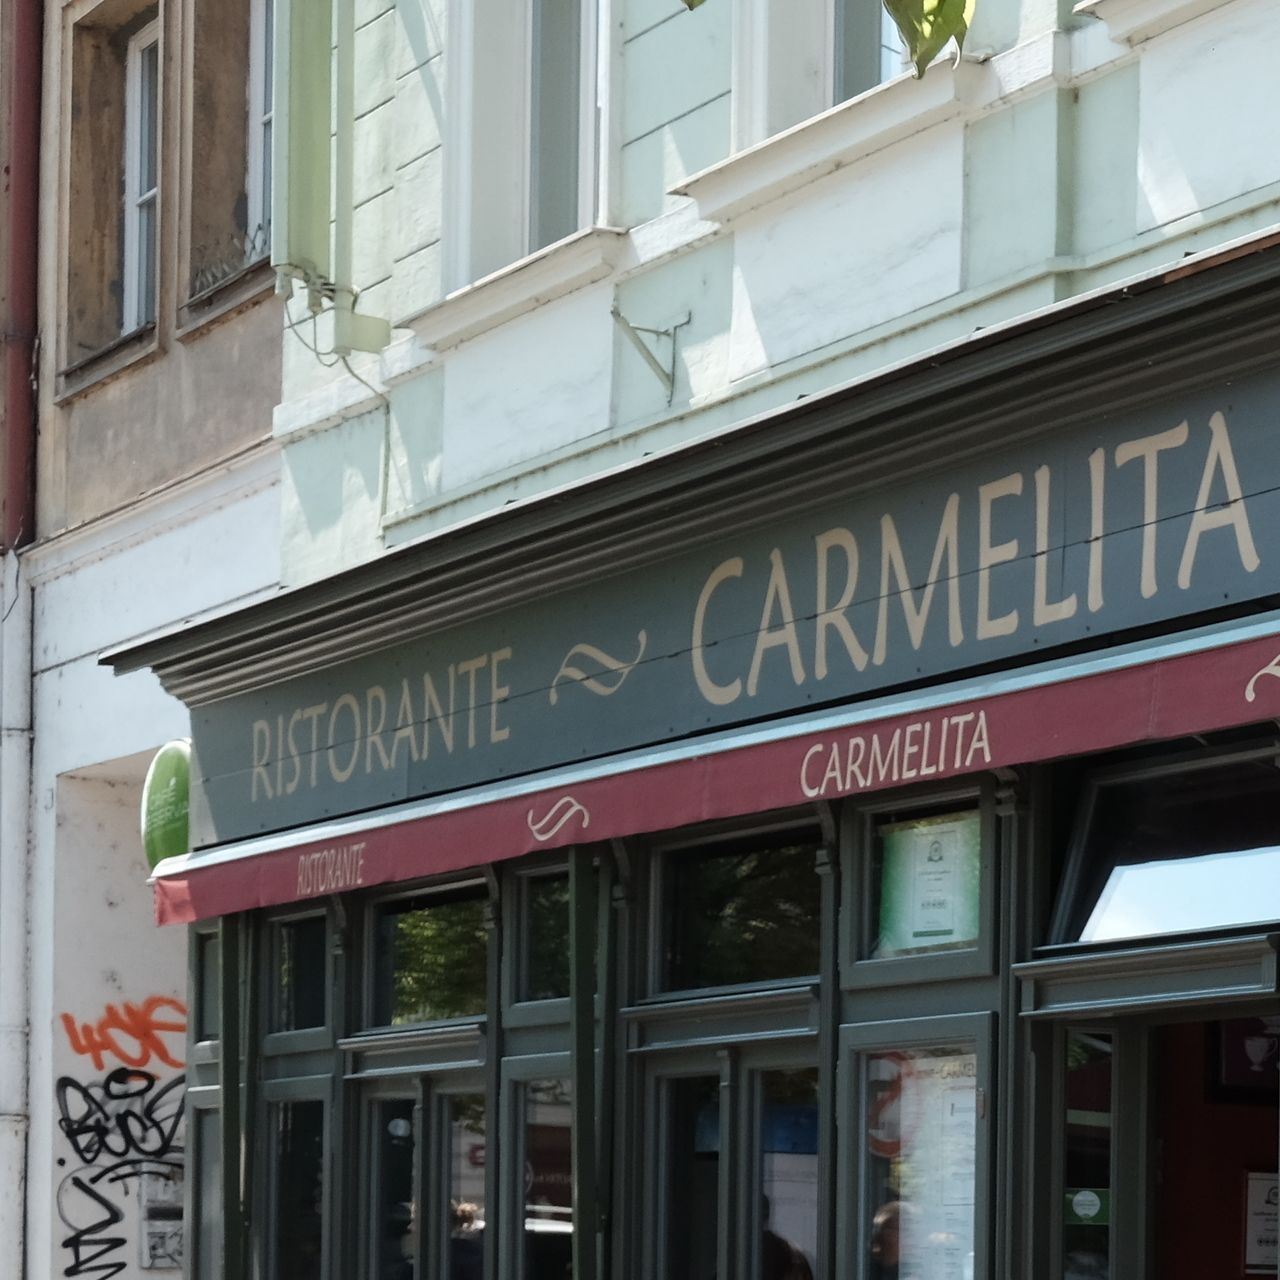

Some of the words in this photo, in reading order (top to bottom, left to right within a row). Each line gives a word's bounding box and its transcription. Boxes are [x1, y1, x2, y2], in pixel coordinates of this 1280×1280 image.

[250, 646, 514, 803] RISTORANTE
[691, 410, 1260, 706] CARMELITA
[297, 842, 365, 898] RISTORANTE
[800, 709, 992, 798] CARMELITA
